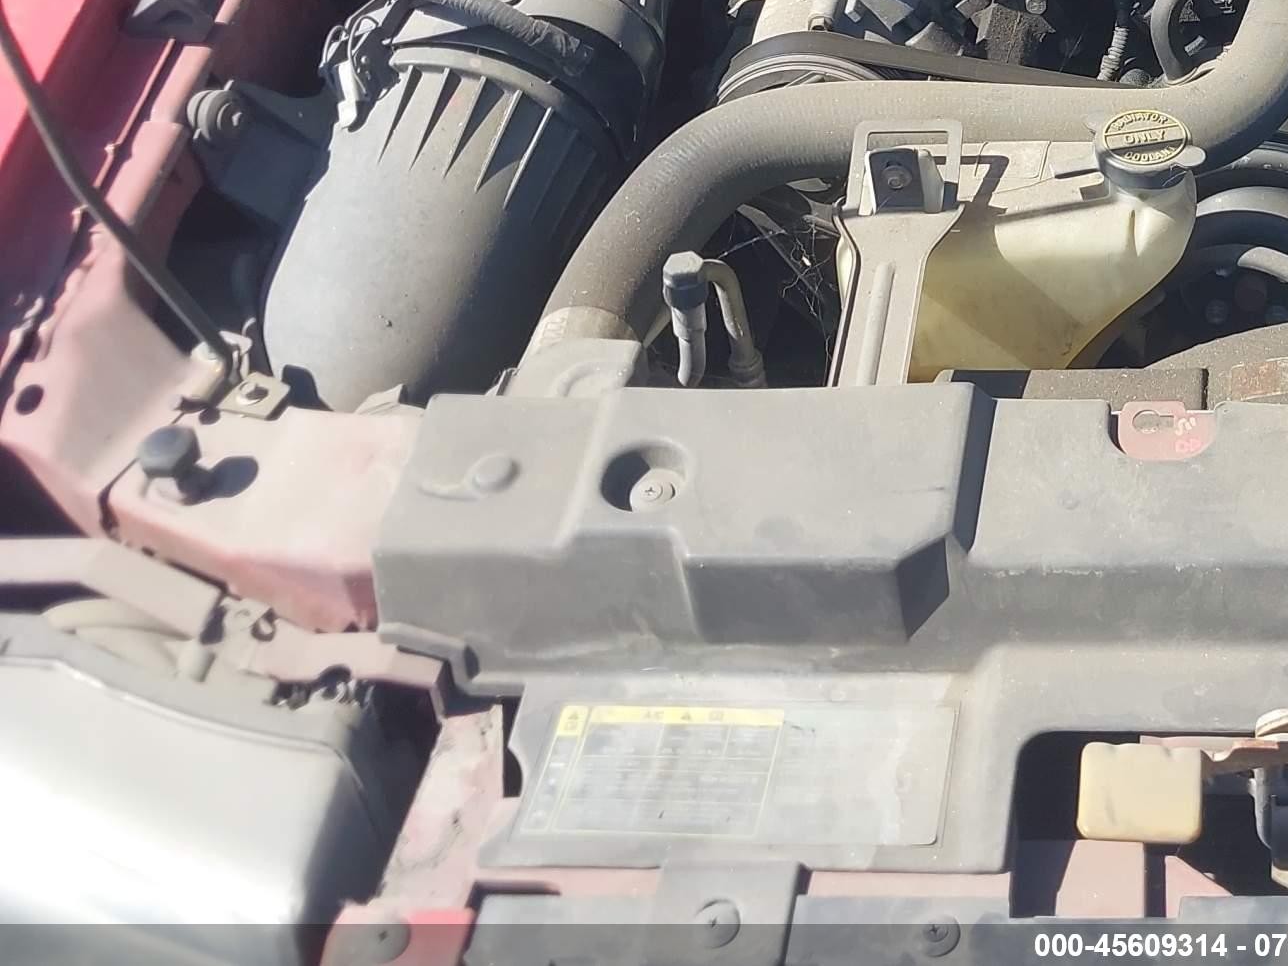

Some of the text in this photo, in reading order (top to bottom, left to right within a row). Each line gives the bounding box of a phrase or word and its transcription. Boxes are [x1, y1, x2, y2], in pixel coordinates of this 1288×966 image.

[1111, 113, 1169, 131] RADIATOR
[1124, 130, 1166, 145] ONLY
[1125, 146, 1176, 162] COOLANT
